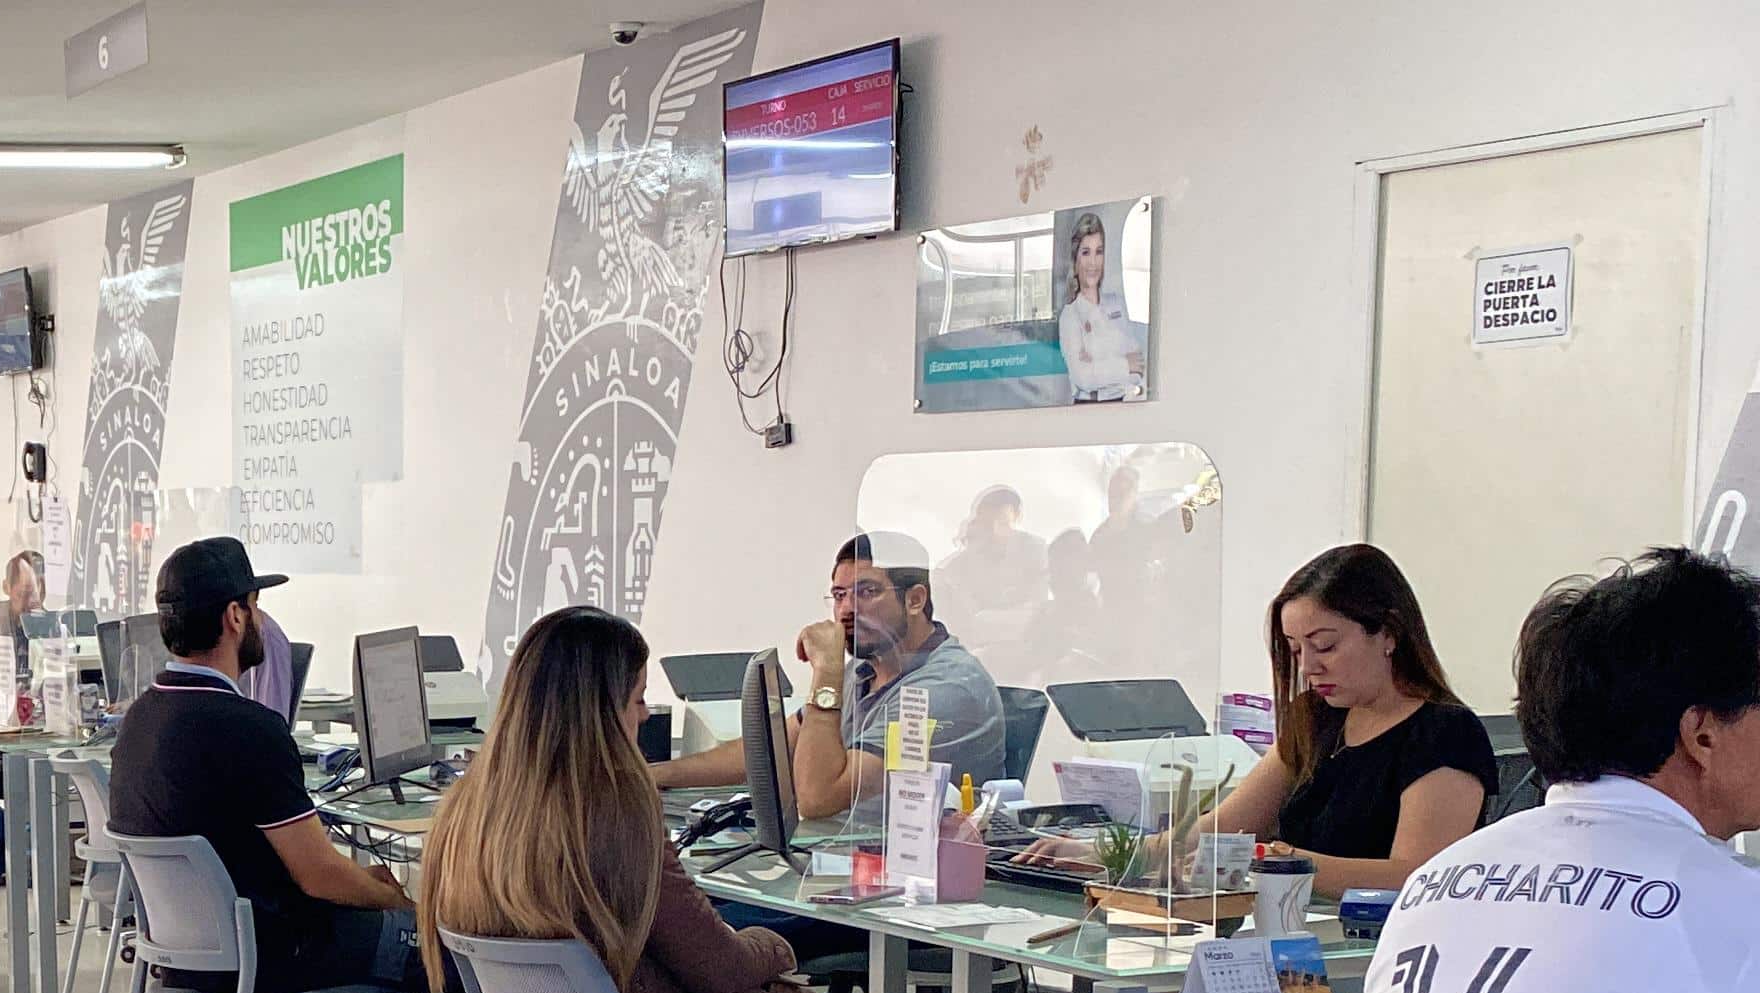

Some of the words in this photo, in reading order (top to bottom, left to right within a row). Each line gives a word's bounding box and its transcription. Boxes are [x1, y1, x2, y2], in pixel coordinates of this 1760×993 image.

[97, 35, 109, 70] 6
[853, 74, 890, 94] SERVICIO
[761, 100, 787, 115] TURNO
[831, 106, 846, 126] 14
[282, 199, 392, 261] NUESTROS
[295, 235, 392, 290] VALORES
[1484, 276, 1535, 296] CIERRE
[1537, 274, 1556, 290] LA
[1483, 293, 1540, 313] PUERTA
[242, 313, 325, 348] AMABILIDAD
[1483, 308, 1558, 329] DESPACIO
[243, 352, 300, 381] RESPETO
[969, 359, 989, 372] para
[555, 347, 680, 416] SINALOA
[243, 383, 328, 414] HONESTIDAD
[99, 404, 161, 452] SINALOA
[243, 415, 352, 448] TRANSPARENCIA
[240, 487, 315, 513] EFICIENCIA
[240, 521, 335, 545] COMPROMISO
[1400, 863, 1681, 919] CHICHARITO
[1204, 951, 1234, 961] Marzo
